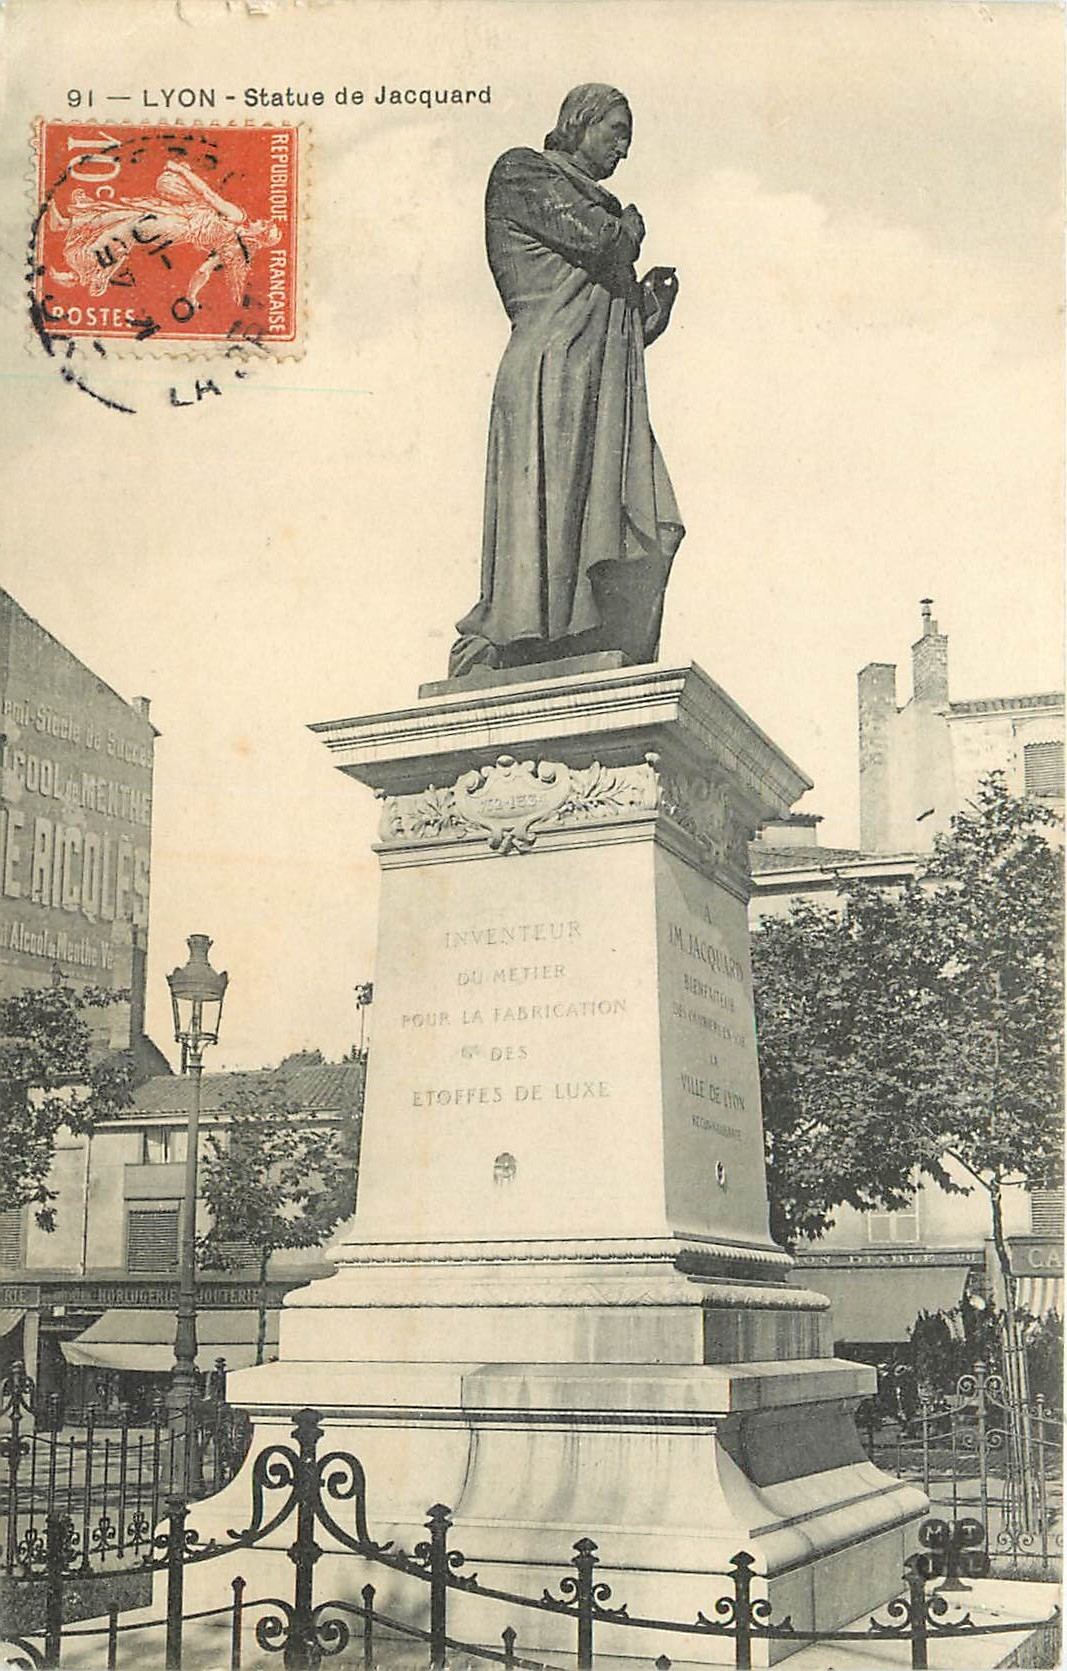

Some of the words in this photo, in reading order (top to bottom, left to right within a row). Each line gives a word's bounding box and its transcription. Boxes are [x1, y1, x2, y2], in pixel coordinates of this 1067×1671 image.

[270, 133, 289, 223] REPUBLIQUE
[51, 305, 137, 328] POSTES
[81, 771, 152, 826] MENTHE
[444, 919, 582, 949] INVENTEUR
[457, 970, 483, 986] DU
[401, 1012, 451, 1030] POUR
[462, 1008, 484, 1025] LA
[493, 998, 628, 1023] FABRICATION
[490, 1045, 529, 1062] DES
[412, 1086, 503, 1108] ETOFFES
[514, 1084, 543, 1102] DE
[554, 1080, 612, 1101] LUXE
[679, 1071, 706, 1099] VILLE
[709, 1083, 722, 1105] DE
[723, 1087, 746, 1112] LYON
